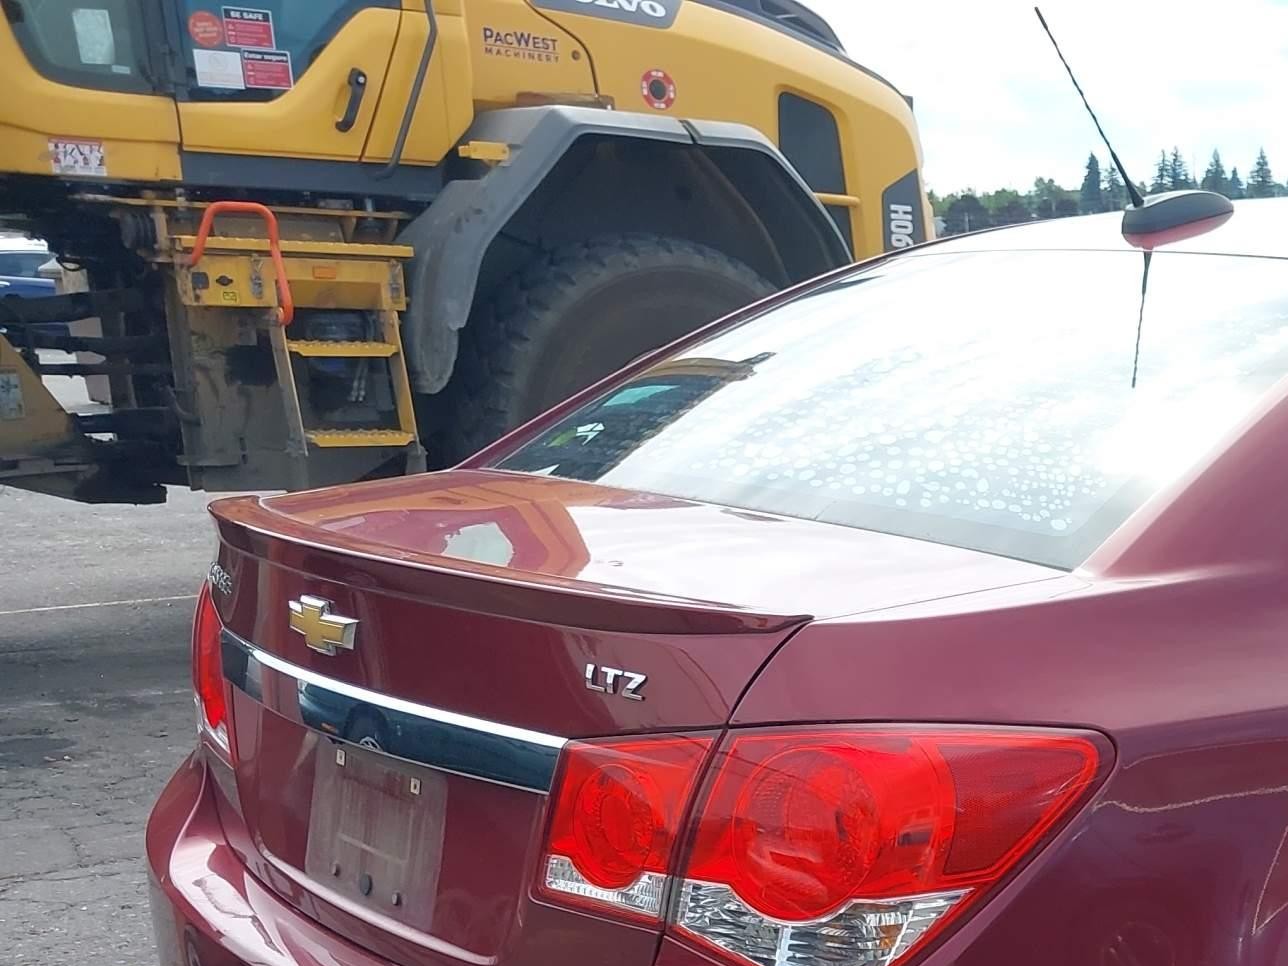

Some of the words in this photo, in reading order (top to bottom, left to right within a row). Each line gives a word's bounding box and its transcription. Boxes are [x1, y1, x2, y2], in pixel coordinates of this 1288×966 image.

[242, 12, 263, 20] SAFE
[484, 47, 559, 62] MACHINERY
[890, 204, 913, 248] 90H
[585, 663, 647, 701] LTZ
